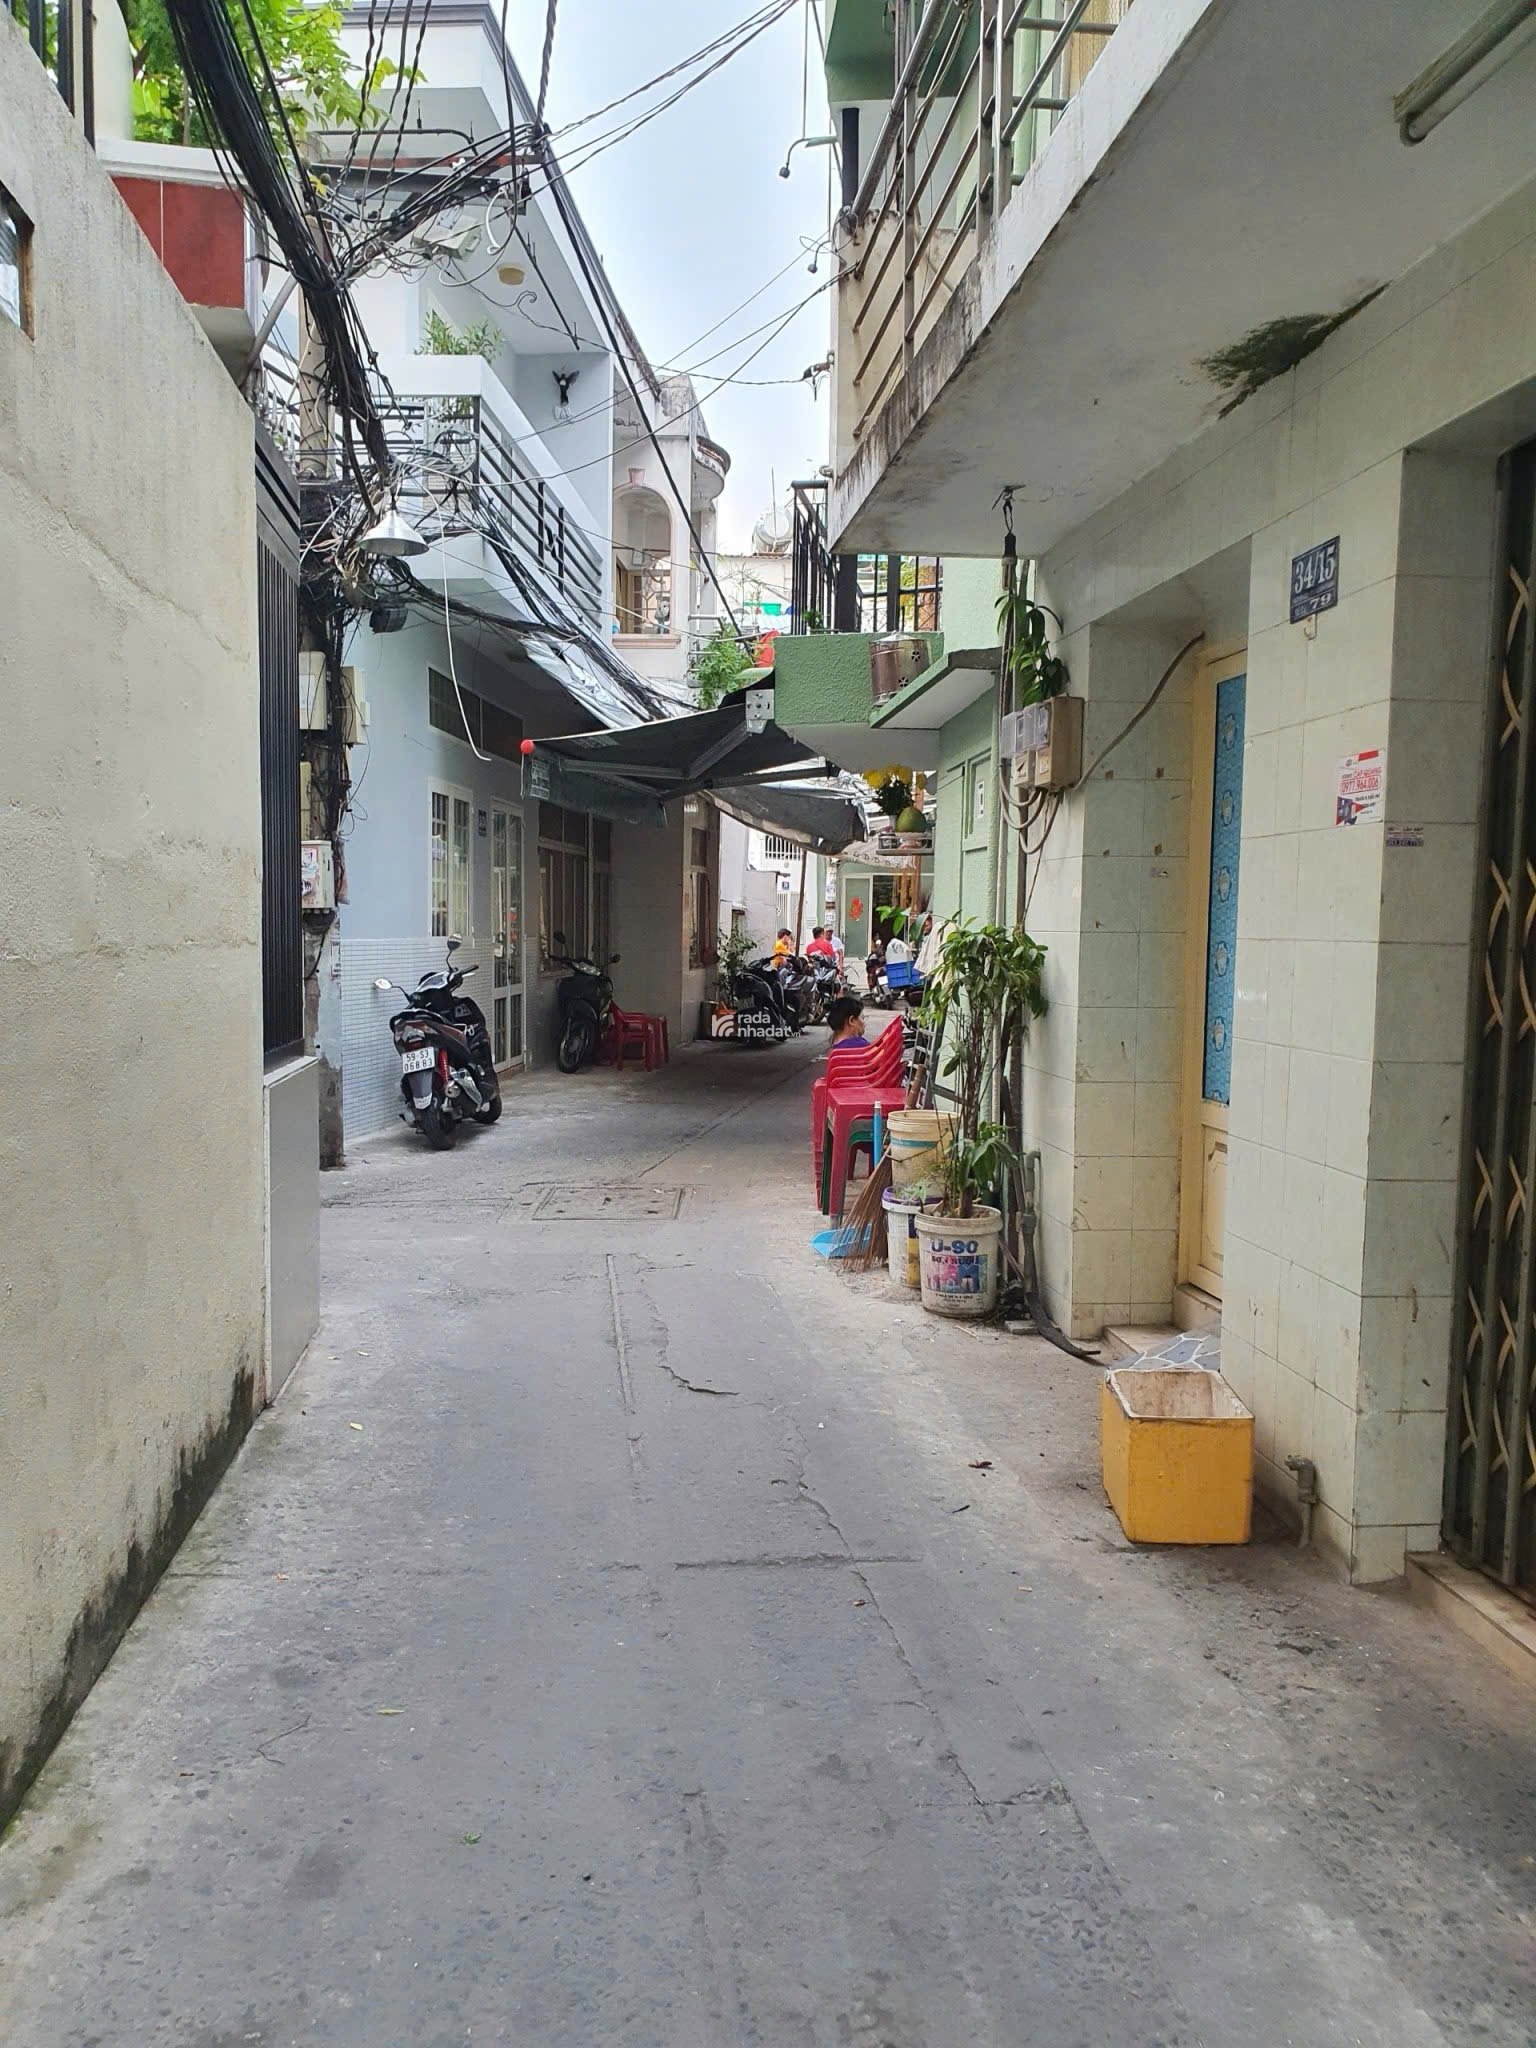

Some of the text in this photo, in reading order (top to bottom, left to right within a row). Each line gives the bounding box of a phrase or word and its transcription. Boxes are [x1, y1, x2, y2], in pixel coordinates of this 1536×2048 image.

[1294, 544, 1336, 594] 34/15
[1309, 593, 1332, 610] 79
[406, 1049, 429, 1063] 59-S3
